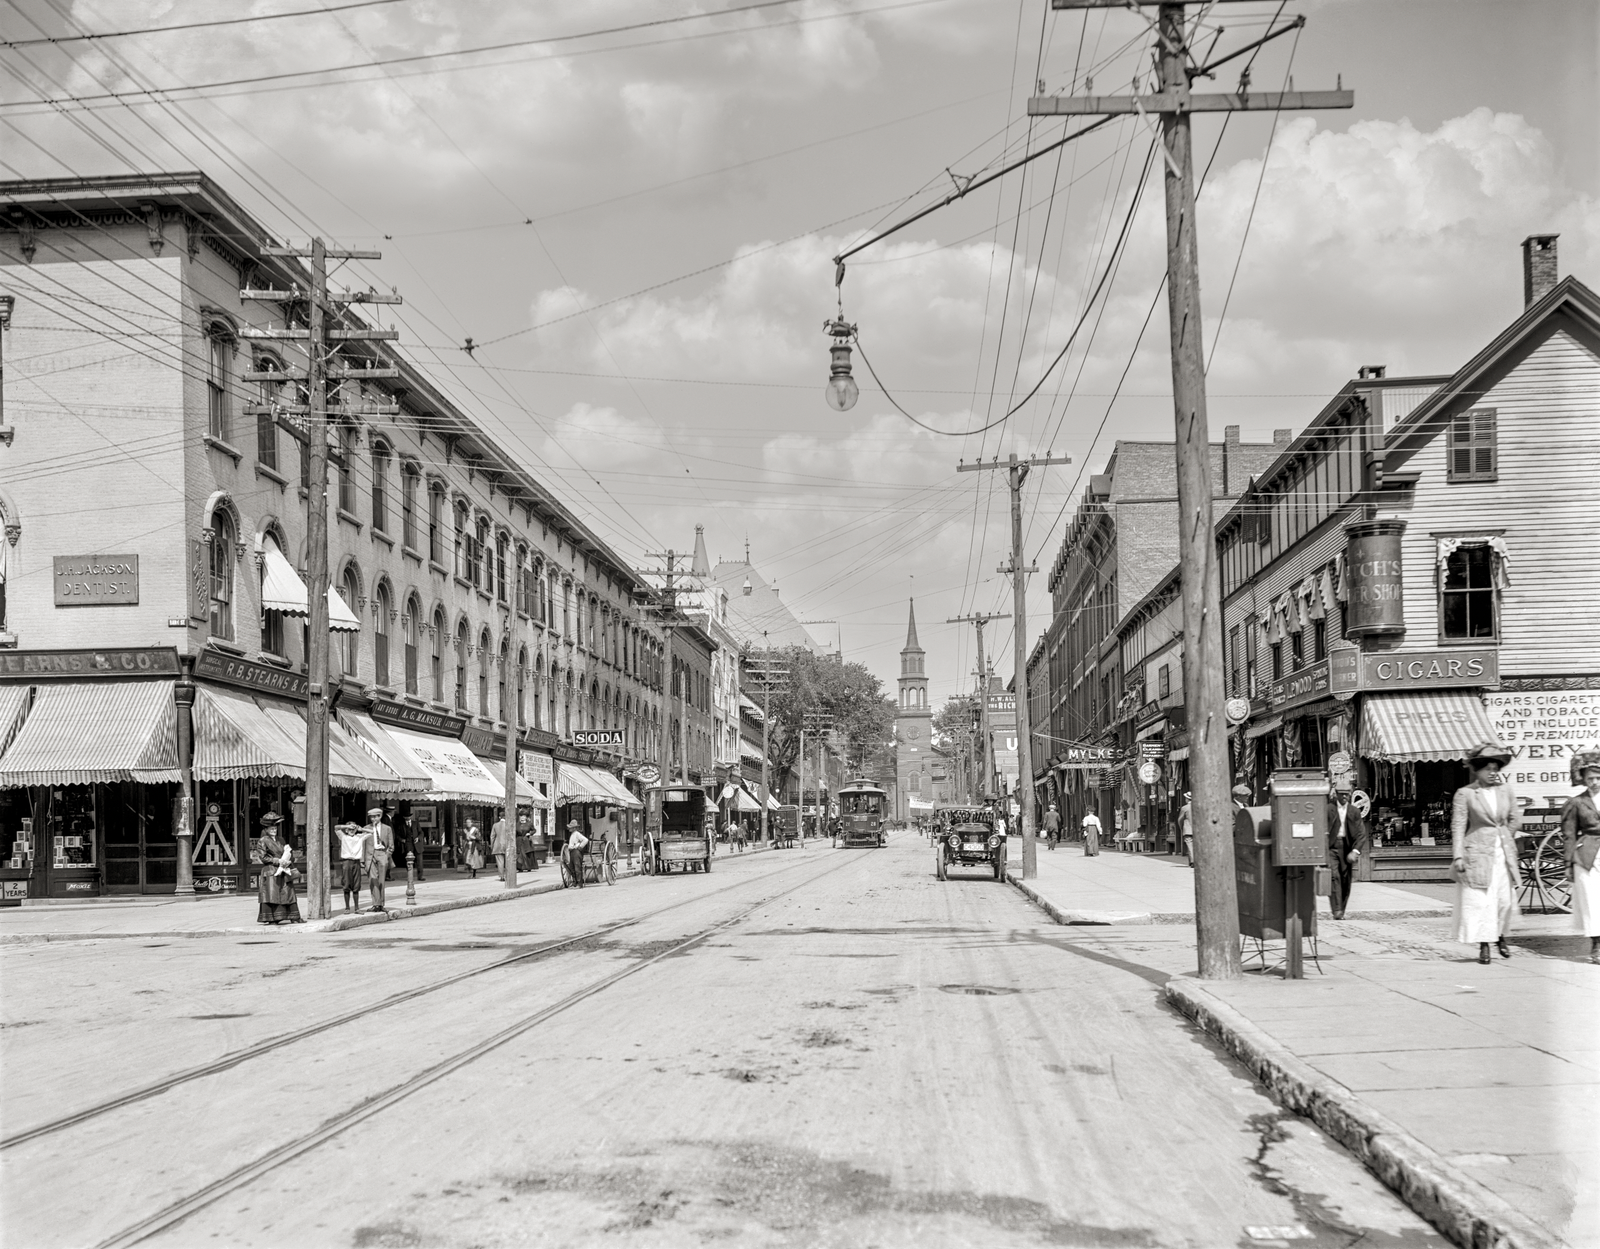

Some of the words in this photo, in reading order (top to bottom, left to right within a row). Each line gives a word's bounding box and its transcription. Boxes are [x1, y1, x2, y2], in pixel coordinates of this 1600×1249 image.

[1373, 584, 1403, 600] SHOP
[95, 654, 111, 670] &
[121, 653, 159, 670] CO.
[1377, 658, 1484, 680] CIGARS
[291, 680, 298, 691] &
[1395, 710, 1470, 724] PIPES
[1501, 708, 1532, 717] AND
[416, 712, 443, 727] MANSUR
[1495, 719, 1527, 728] NOT
[1533, 717, 1599, 728] INCLUDE
[575, 733, 622, 744] SODA
[1007, 737, 1018, 750] U
[1068, 748, 1124, 759] MYLKES
[1516, 772, 1536, 782] BE
[1540, 771, 1572, 782] OBT
[1284, 847, 1324, 859] MAIL
